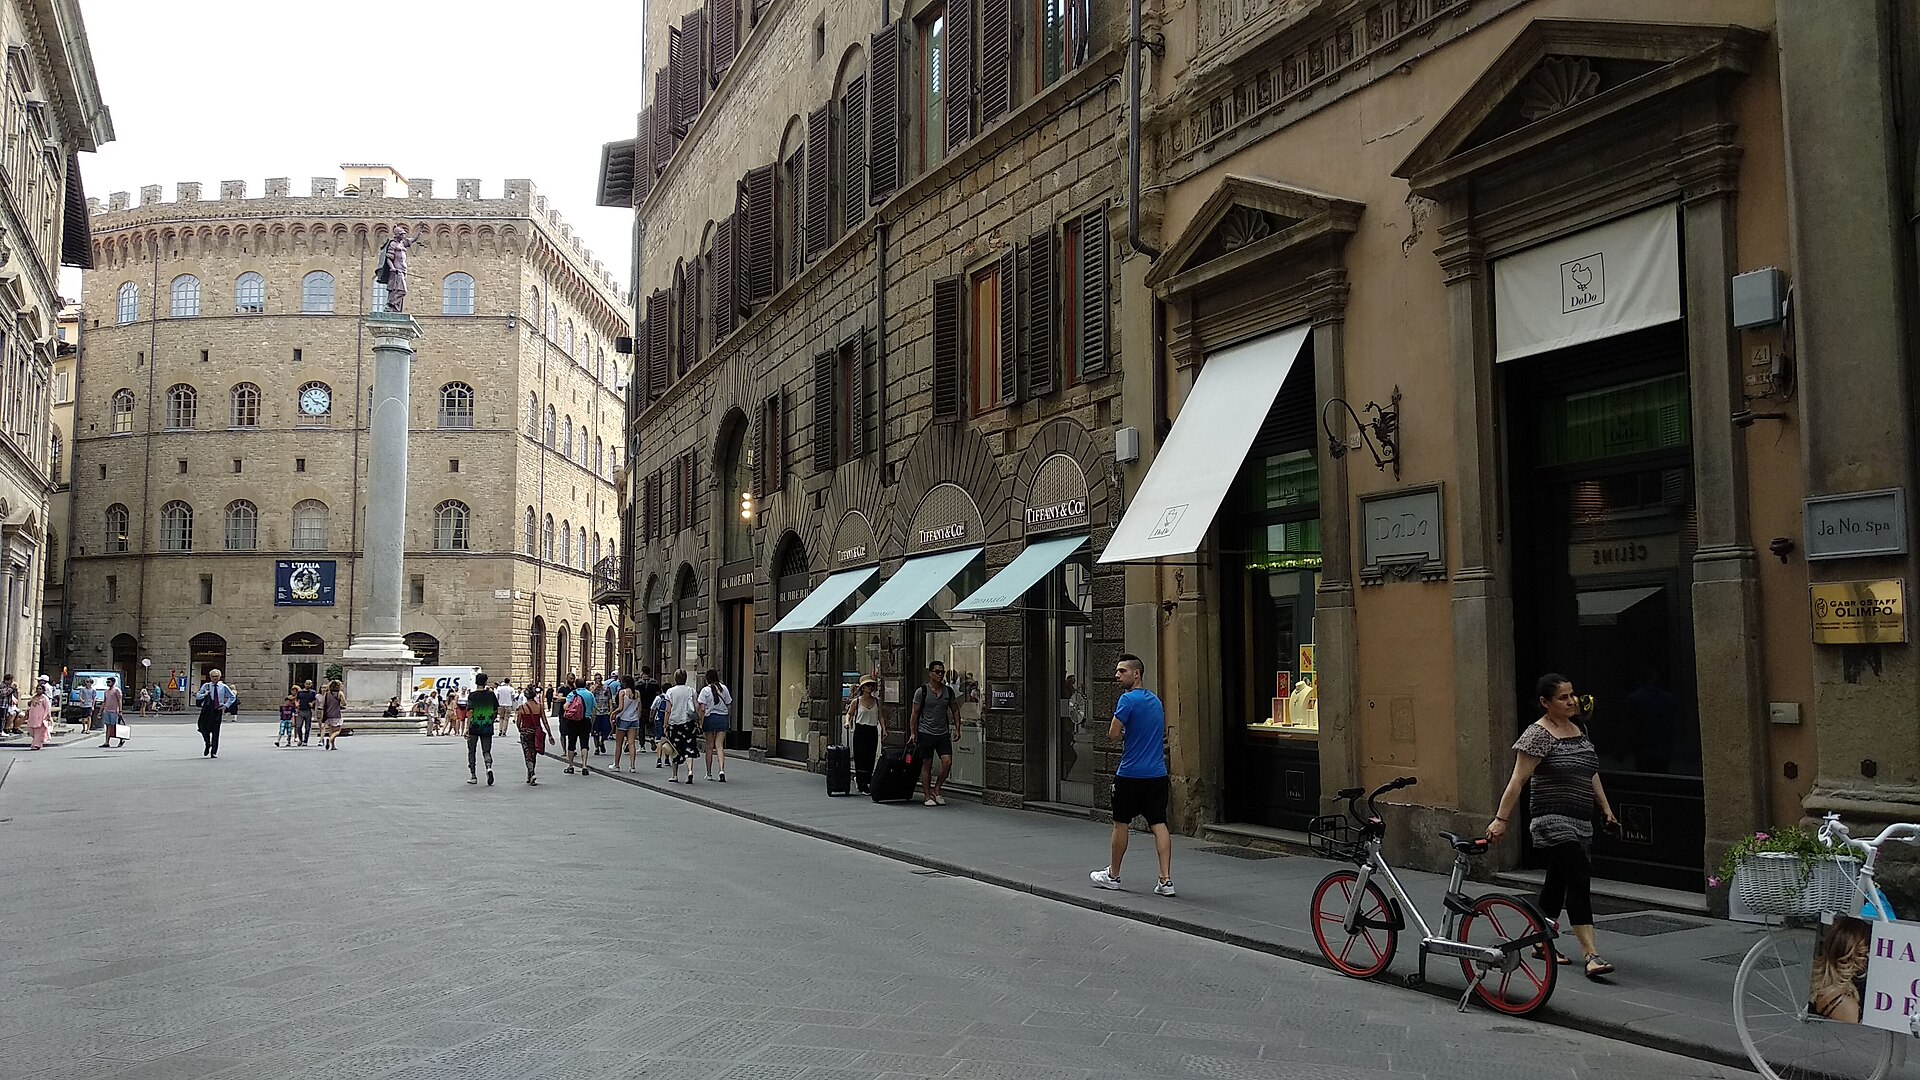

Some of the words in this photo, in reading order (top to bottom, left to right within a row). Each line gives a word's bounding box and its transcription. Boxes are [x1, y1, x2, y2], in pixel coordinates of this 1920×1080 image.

[1571, 292, 1598, 308] DoDo
[1374, 512, 1429, 541] DoDo
[1865, 521, 1891, 536] Spa
[780, 588, 809, 602] BURBERR
[1829, 598, 1898, 608] GABROSTAFF
[1835, 606, 1893, 618] OLIMPO
[435, 677, 461, 689] GLS
